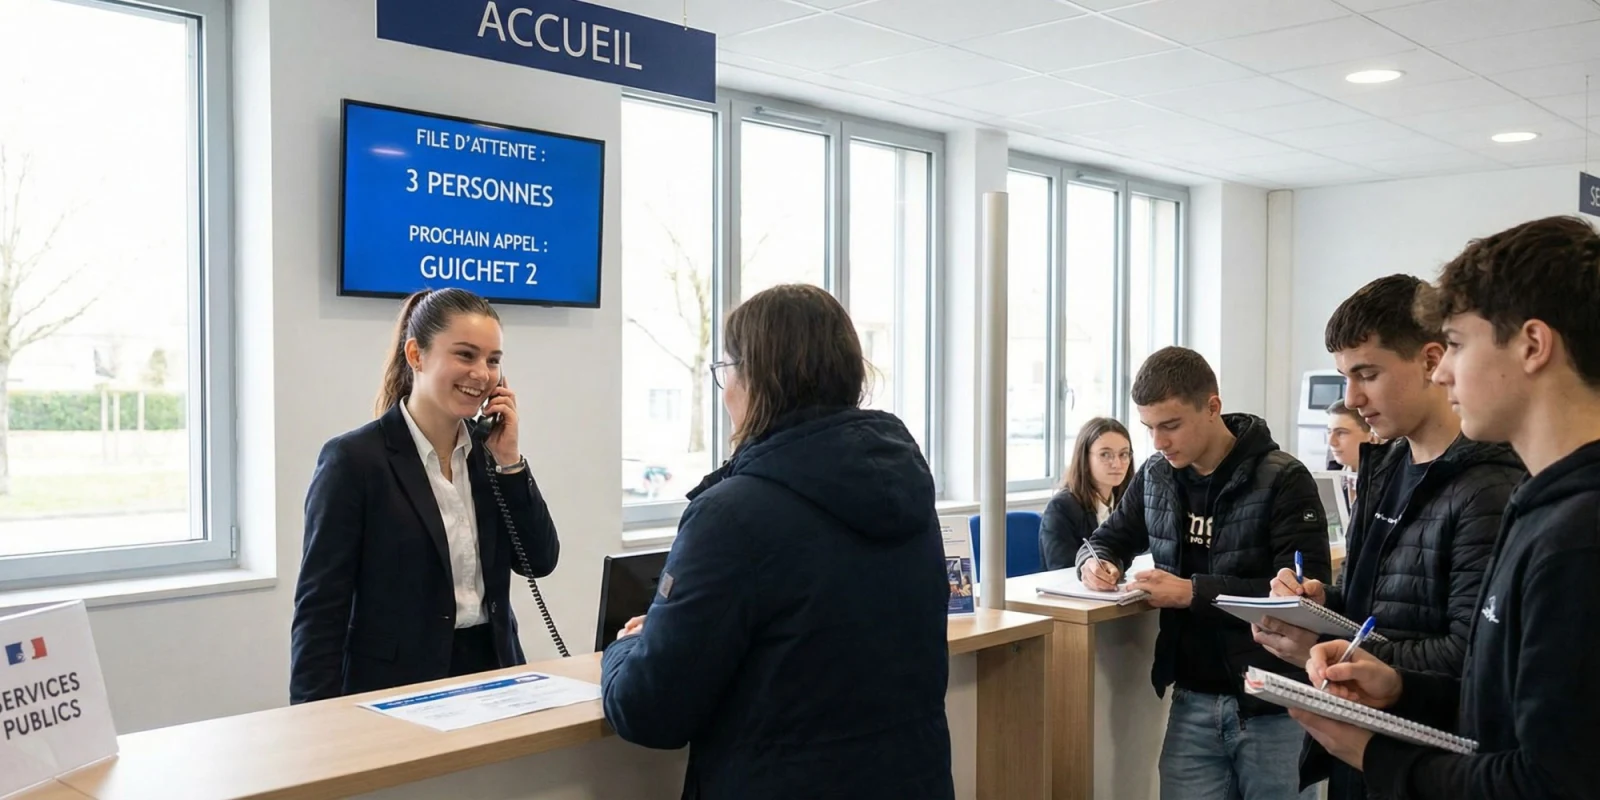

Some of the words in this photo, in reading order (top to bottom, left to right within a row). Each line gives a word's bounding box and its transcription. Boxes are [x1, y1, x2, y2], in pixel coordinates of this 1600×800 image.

[477, 0, 643, 71] ACCUEIL
[417, 128, 450, 149] FILE
[541, 150, 546, 162] :
[406, 168, 419, 192] 3
[428, 171, 554, 208] PERSONNES
[409, 224, 490, 248] PROCHAIN
[494, 233, 540, 252] APPEL
[543, 240, 548, 253] :
[420, 255, 520, 283] GUICHET
[525, 262, 538, 285] 2
[0, 672, 80, 713] ERVICES
[3, 699, 82, 741] PUBLICS
